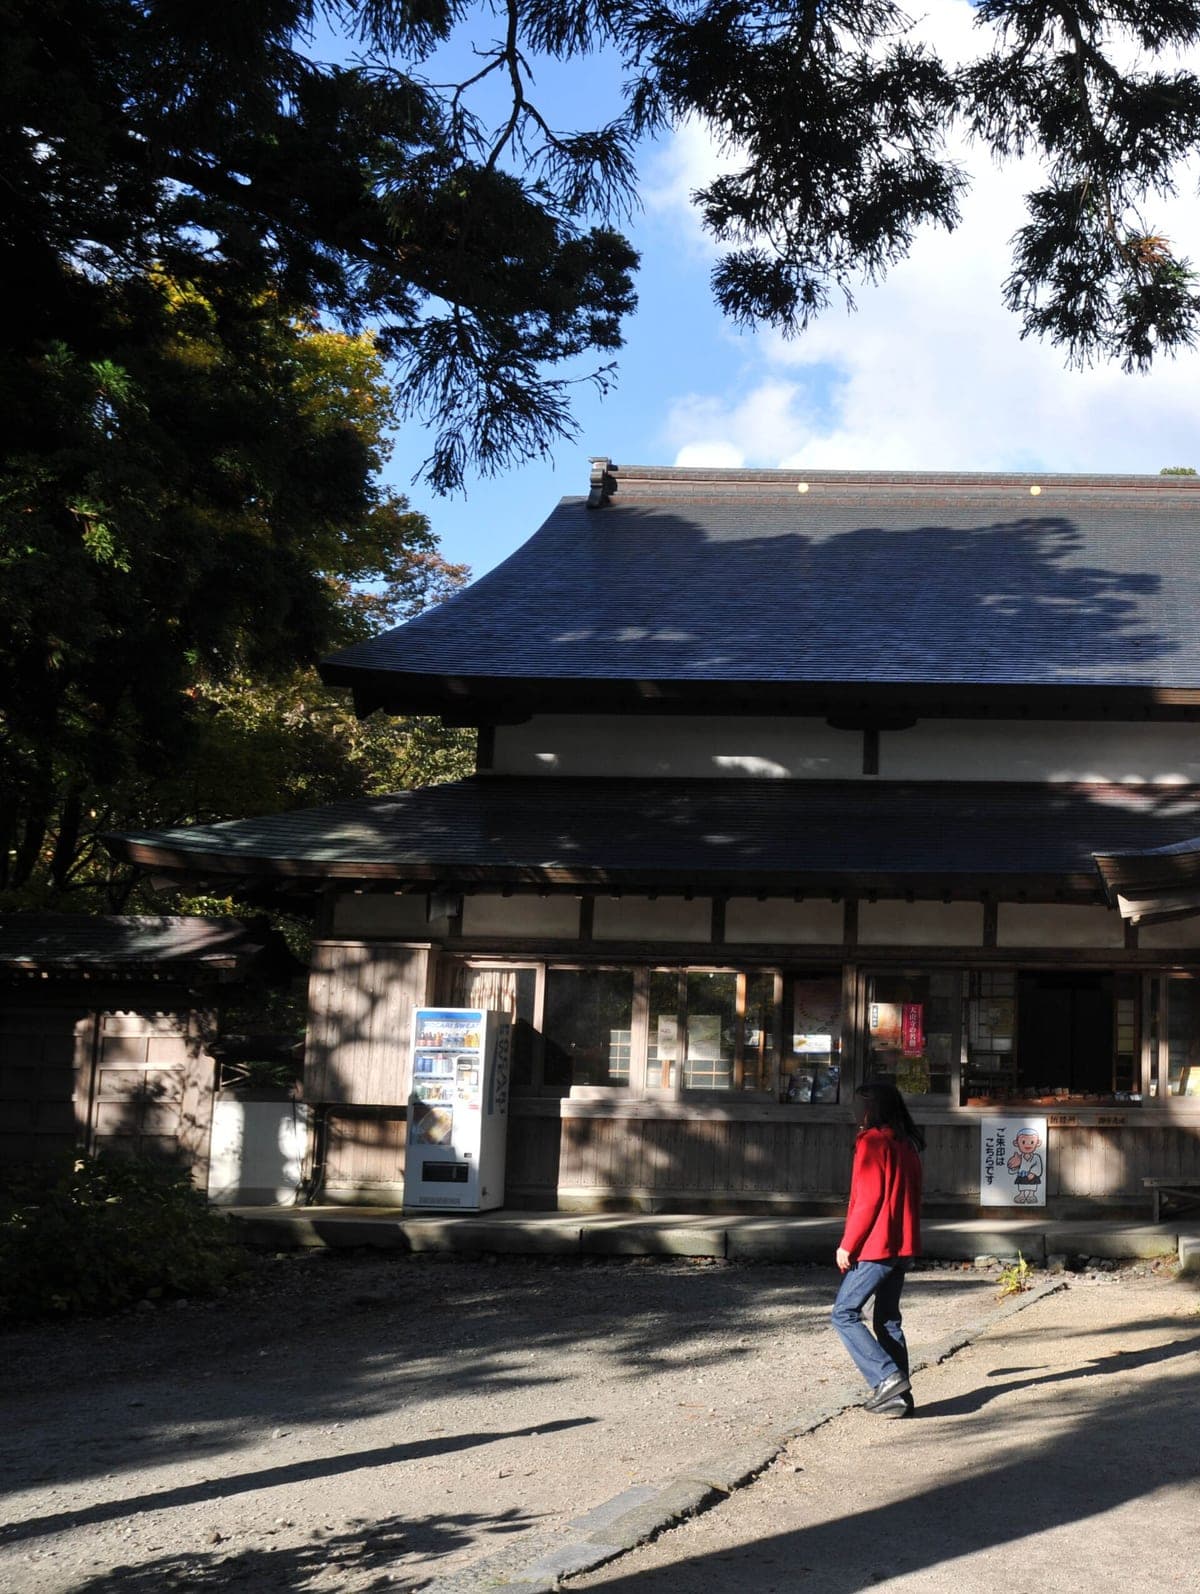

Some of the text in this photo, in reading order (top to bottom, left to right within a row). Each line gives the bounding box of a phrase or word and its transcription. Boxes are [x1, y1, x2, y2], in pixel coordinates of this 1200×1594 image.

[984, 1137, 995, 1185] こちらです
